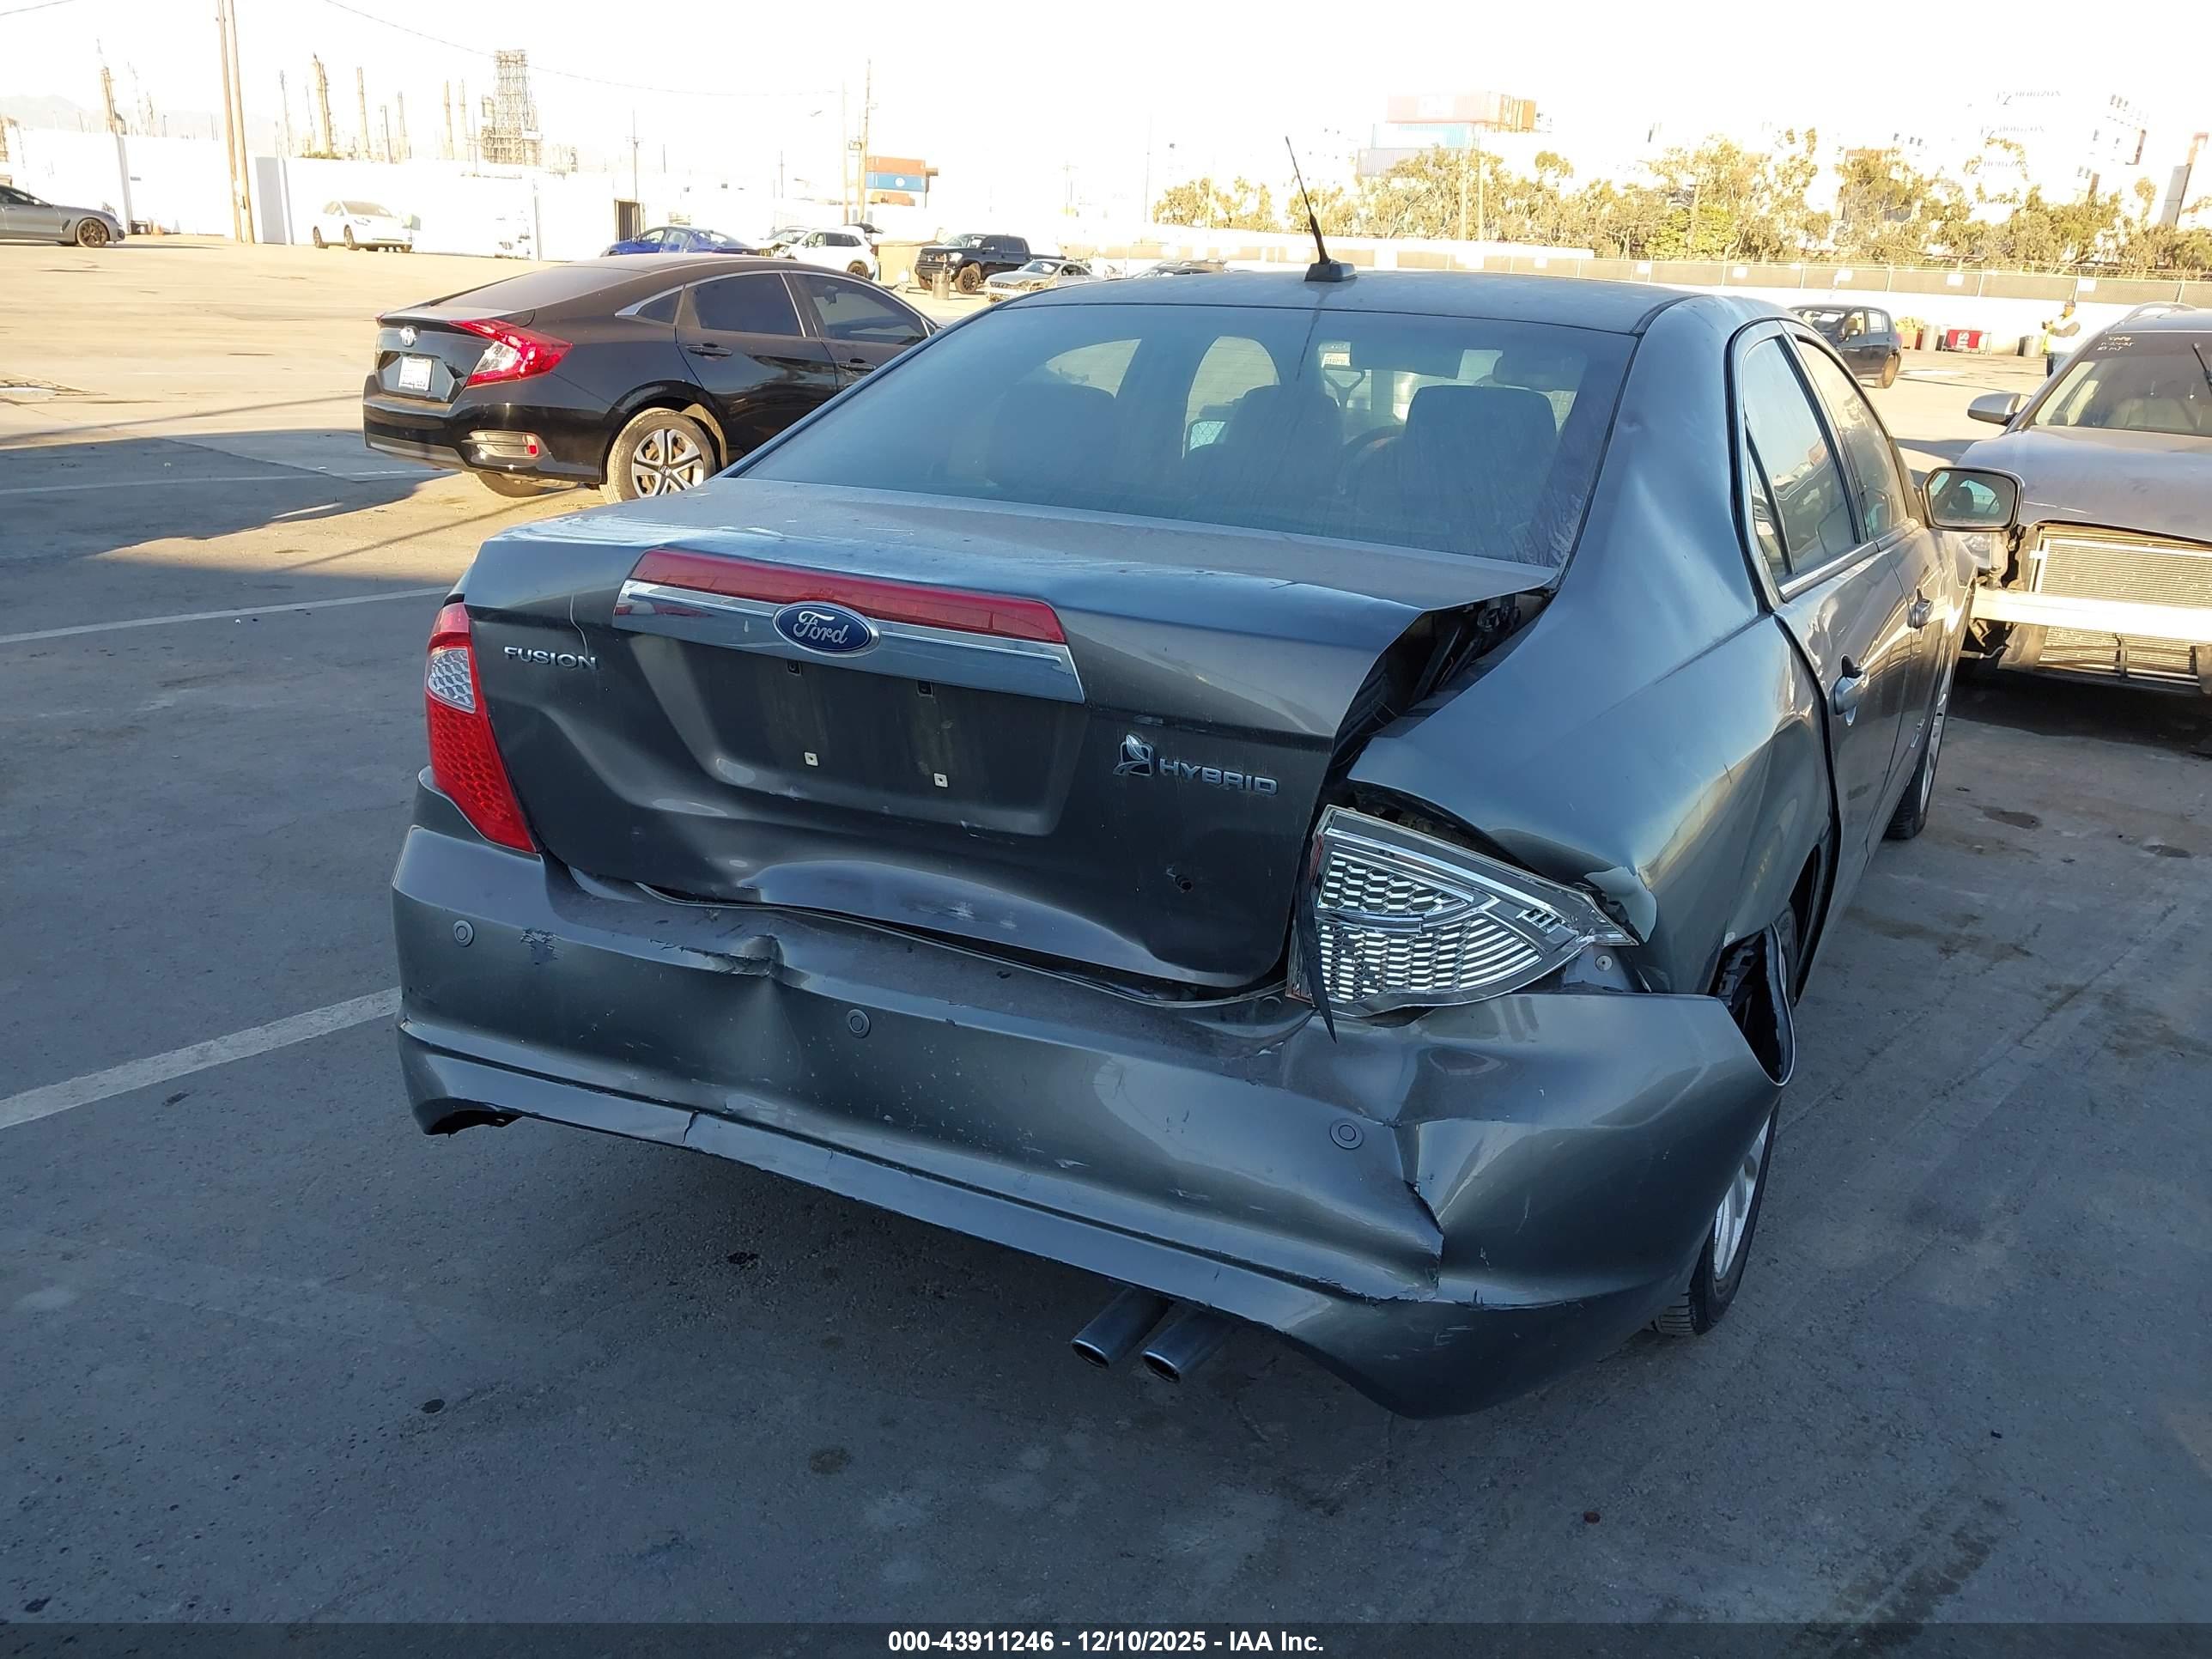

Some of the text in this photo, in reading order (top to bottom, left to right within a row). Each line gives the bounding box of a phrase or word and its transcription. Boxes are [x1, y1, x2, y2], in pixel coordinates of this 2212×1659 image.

[793, 611, 849, 644] Ford
[504, 646, 598, 670] FUSION
[1159, 758, 1279, 796] HYBRID
